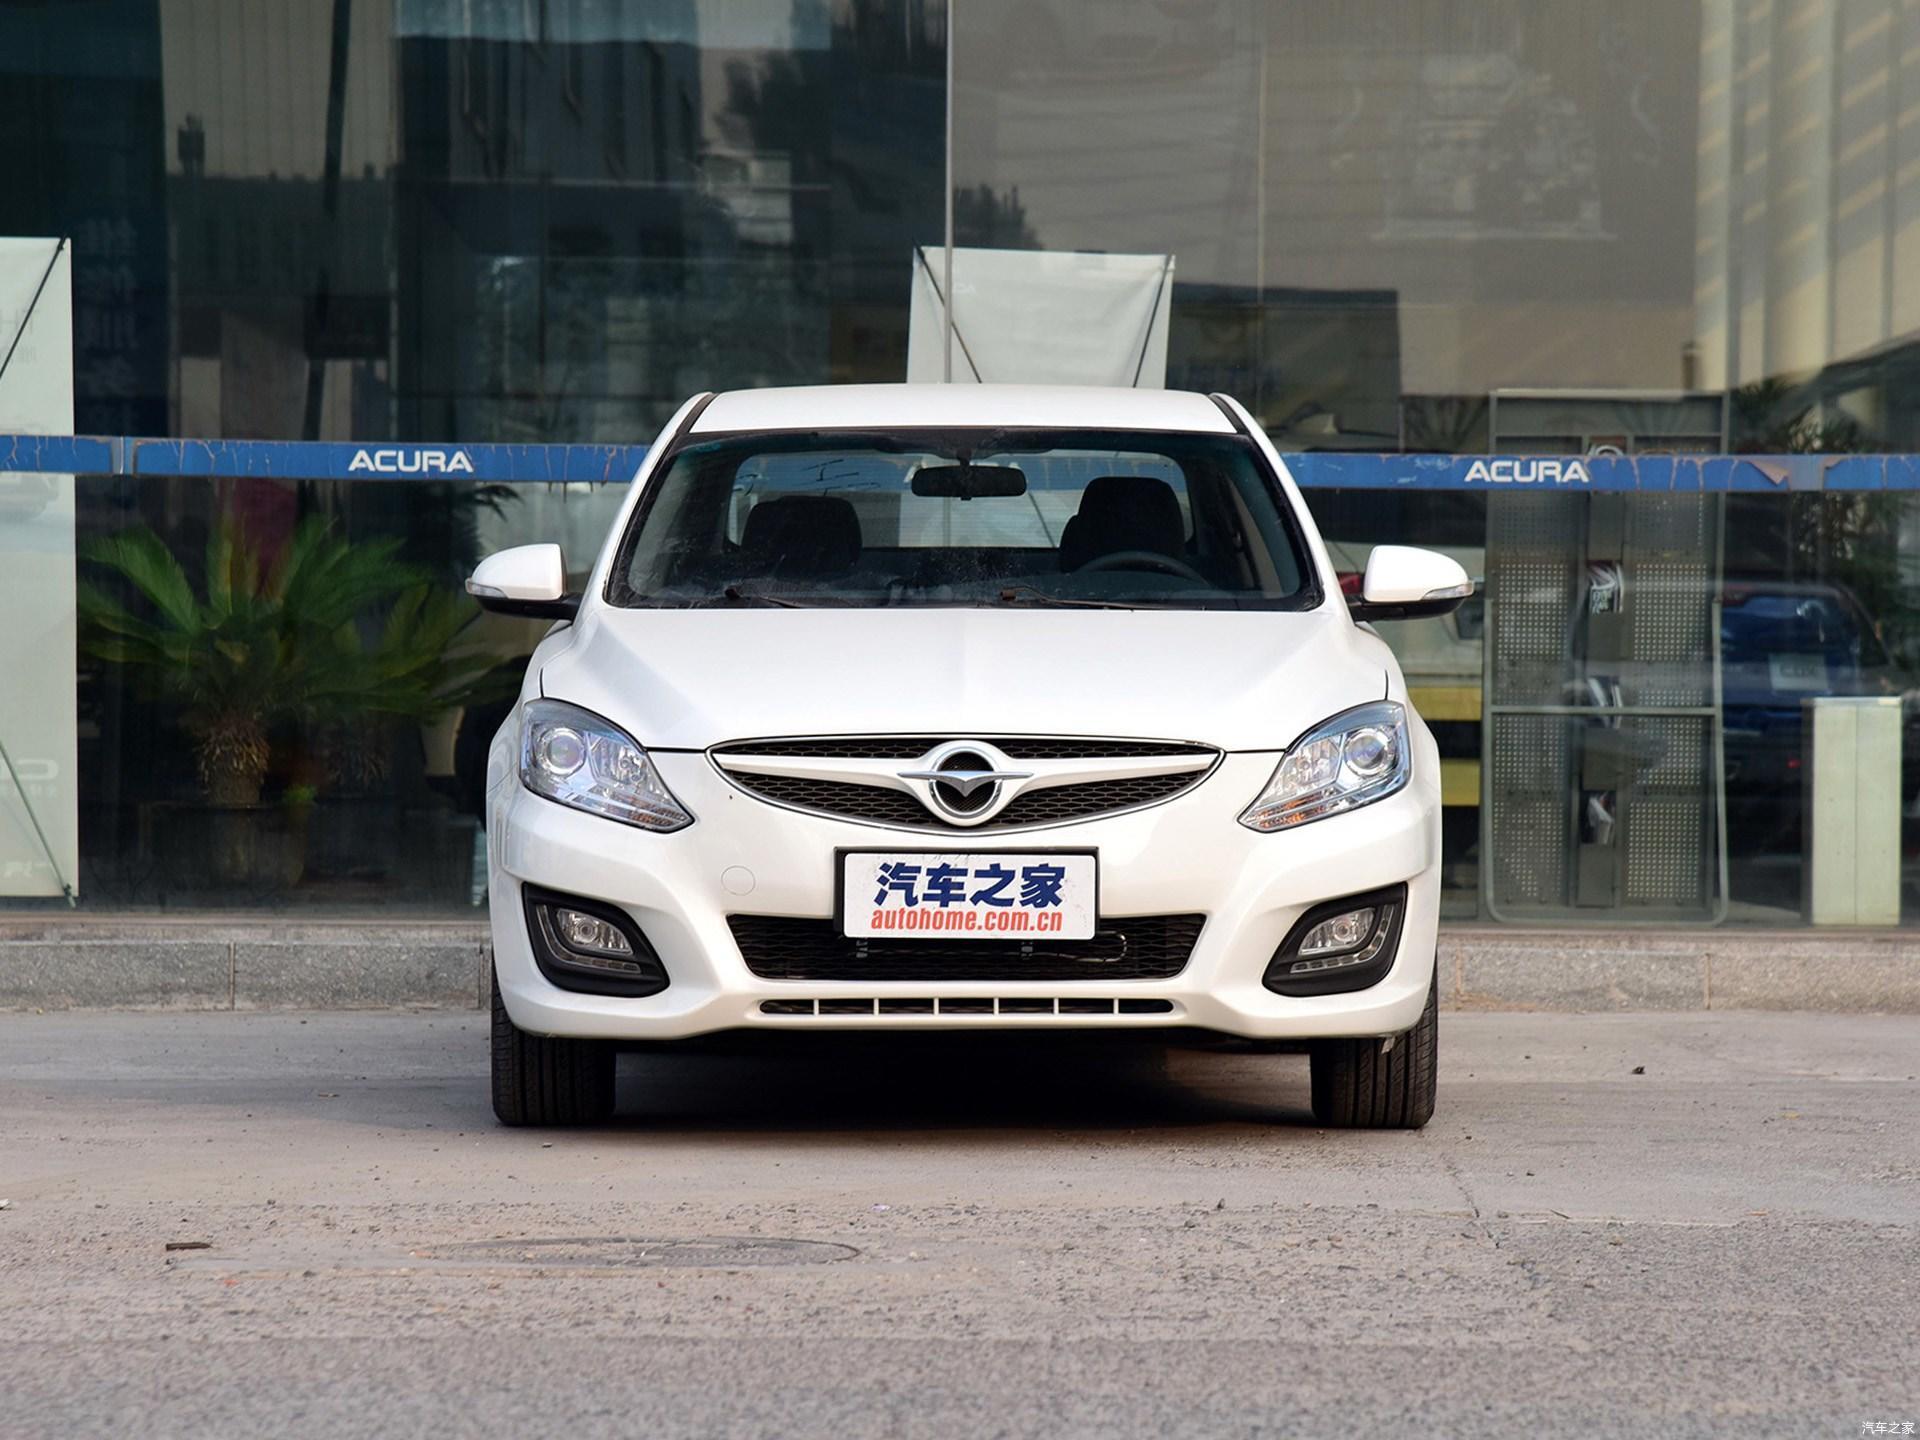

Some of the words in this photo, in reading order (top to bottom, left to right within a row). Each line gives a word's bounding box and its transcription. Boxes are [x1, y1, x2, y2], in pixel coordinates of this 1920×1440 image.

[348, 449, 474, 473] ACURA
[1463, 460, 1590, 482] ACURA
[873, 862, 1066, 908] 汽车之家
[871, 908, 1063, 932] autohome.com.cn
